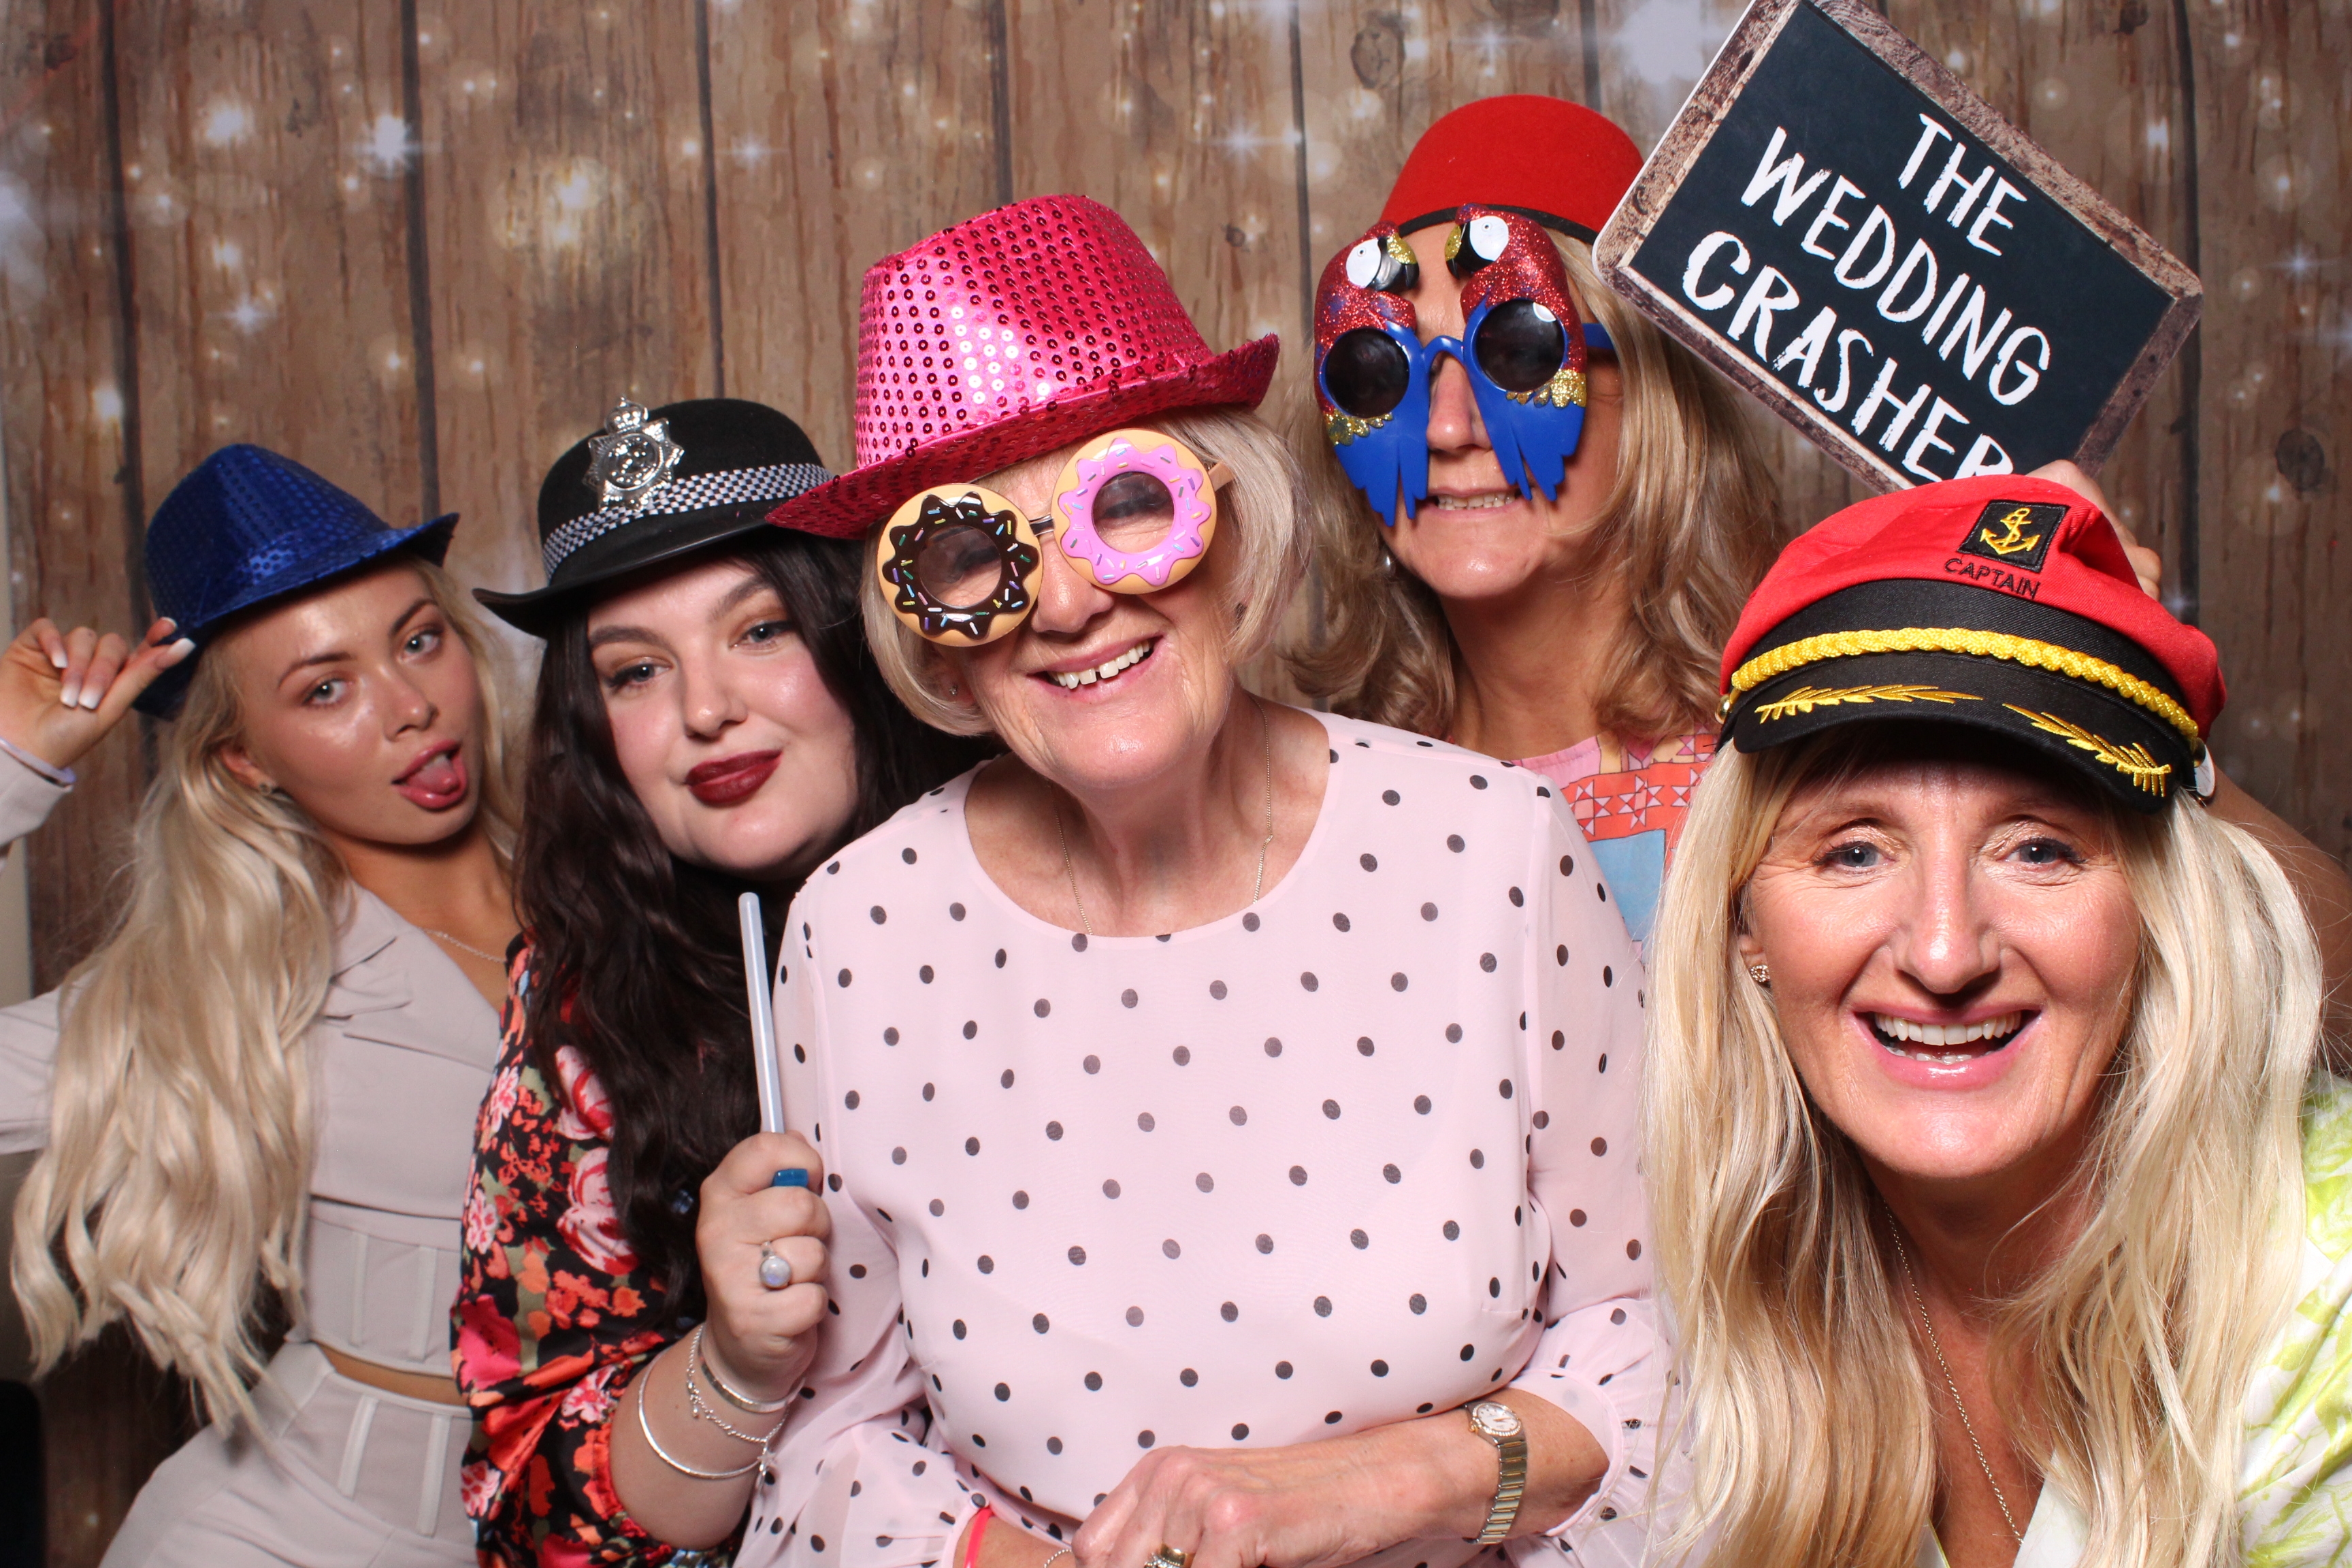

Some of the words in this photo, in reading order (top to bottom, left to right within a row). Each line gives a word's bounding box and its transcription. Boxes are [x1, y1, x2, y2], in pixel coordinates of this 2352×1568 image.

[1740, 126, 2051, 406] WEDDING
[1897, 112, 2027, 257] THE
[1682, 231, 2014, 484] CRASHER
[1944, 557, 2041, 600] CAPTAIN
